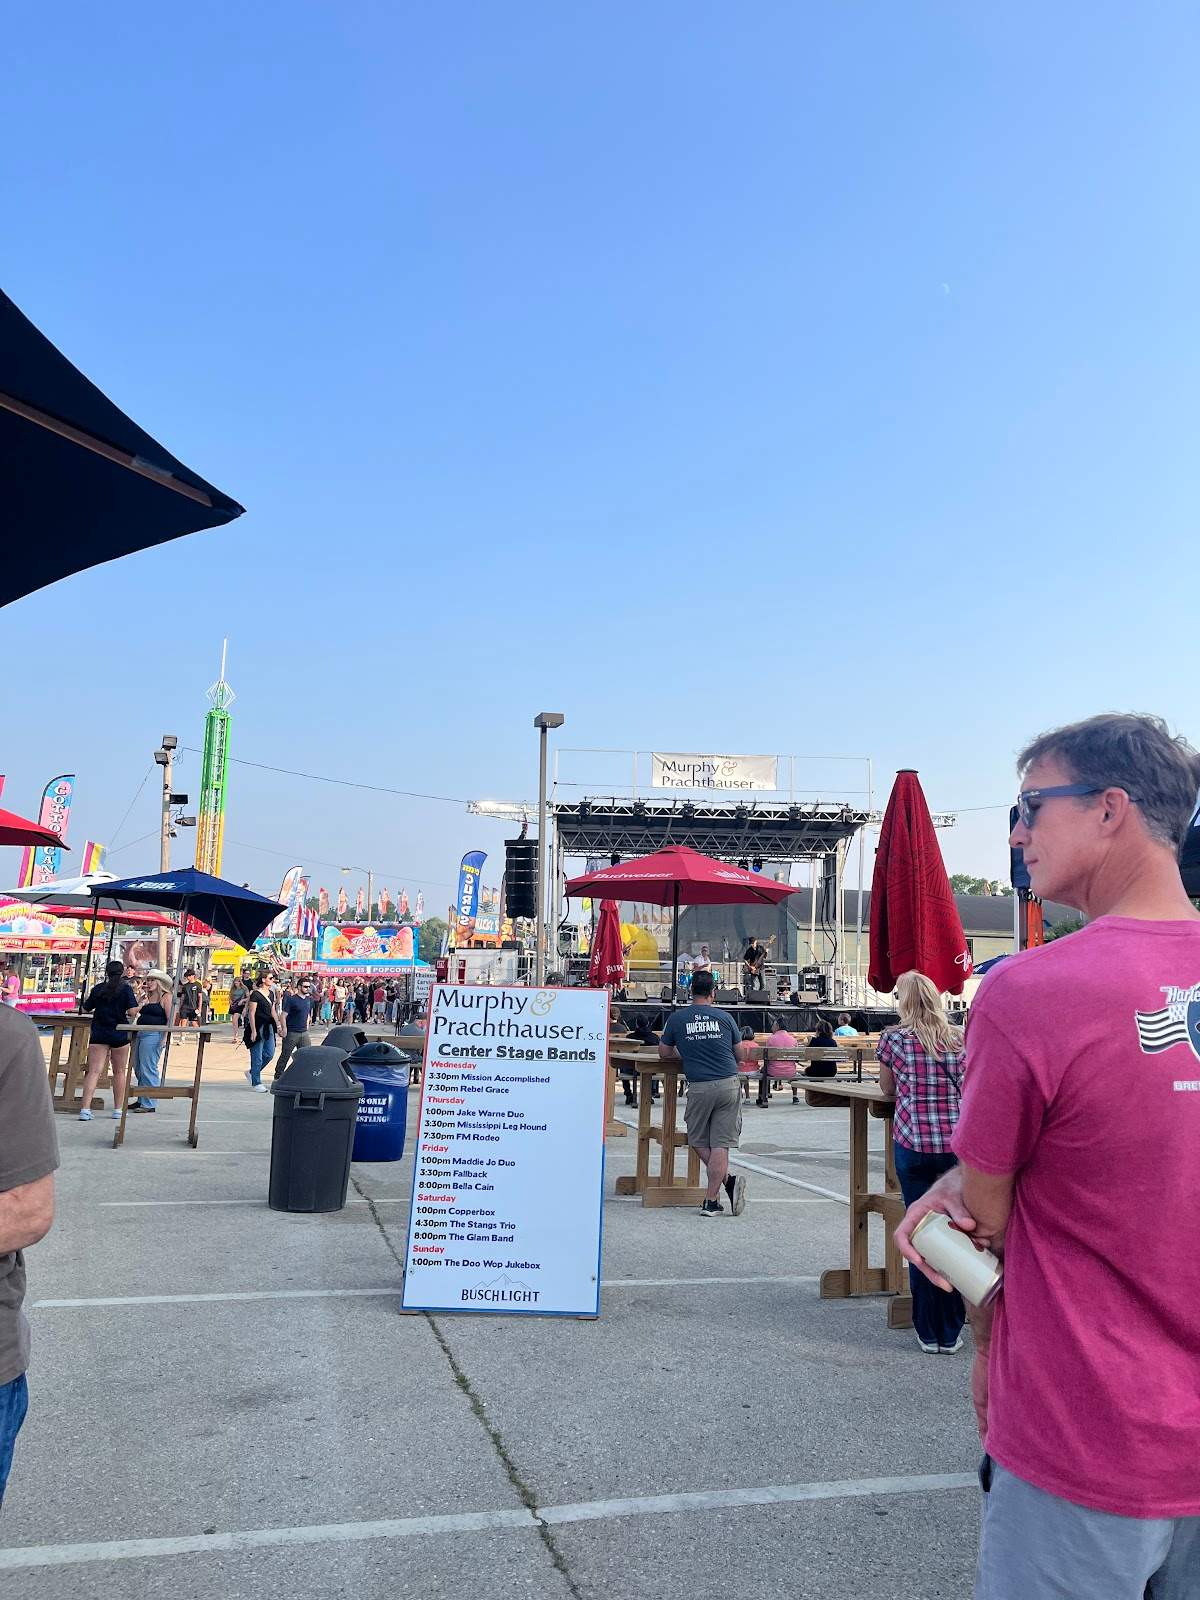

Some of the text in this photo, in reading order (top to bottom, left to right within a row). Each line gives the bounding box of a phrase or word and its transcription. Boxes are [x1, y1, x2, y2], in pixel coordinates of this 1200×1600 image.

[662, 760, 738, 776] Murphy &
[662, 776, 754, 789] Prachthauser
[48, 786, 67, 838] COTTO
[593, 871, 673, 880] Budweiser
[1159, 986, 1200, 1004] Harle
[436, 988, 557, 1016] Murphy &
[438, 1043, 596, 1061] Center Stage Bands
[431, 1060, 477, 1069] Wednesday
[428, 1072, 551, 1083] 3:30pm Mission Accomplished
[427, 1084, 510, 1094] 7:30pm Rebel Grace
[366, 1097, 388, 1106] ONLY
[427, 1096, 465, 1105] Thursday
[357, 1106, 384, 1115] AUKEE
[425, 1108, 525, 1119] 1:00pm Jake Warne Duo
[424, 1120, 547, 1131] 3:30pm Mississippi Leg Hound
[423, 1132, 500, 1142] 7:30pm FM Rodeo
[422, 1144, 449, 1153] Friday
[421, 1156, 516, 1167] 1:00pm Maddie Jo Duo
[420, 1168, 488, 1178] 3:30pm Fallback
[418, 1181, 495, 1191] 8:00pm Bella Cain
[417, 1193, 456, 1203] Saturday
[416, 1206, 496, 1216] 1:00pm Copperbox
[415, 1219, 517, 1230] 4:30pm The Stangs Trio
[414, 1232, 515, 1242] 8:00pm The Glam Band
[412, 1245, 445, 1254] Sunday
[412, 1258, 542, 1270] 1:00pm The Doo Wop Jukebox
